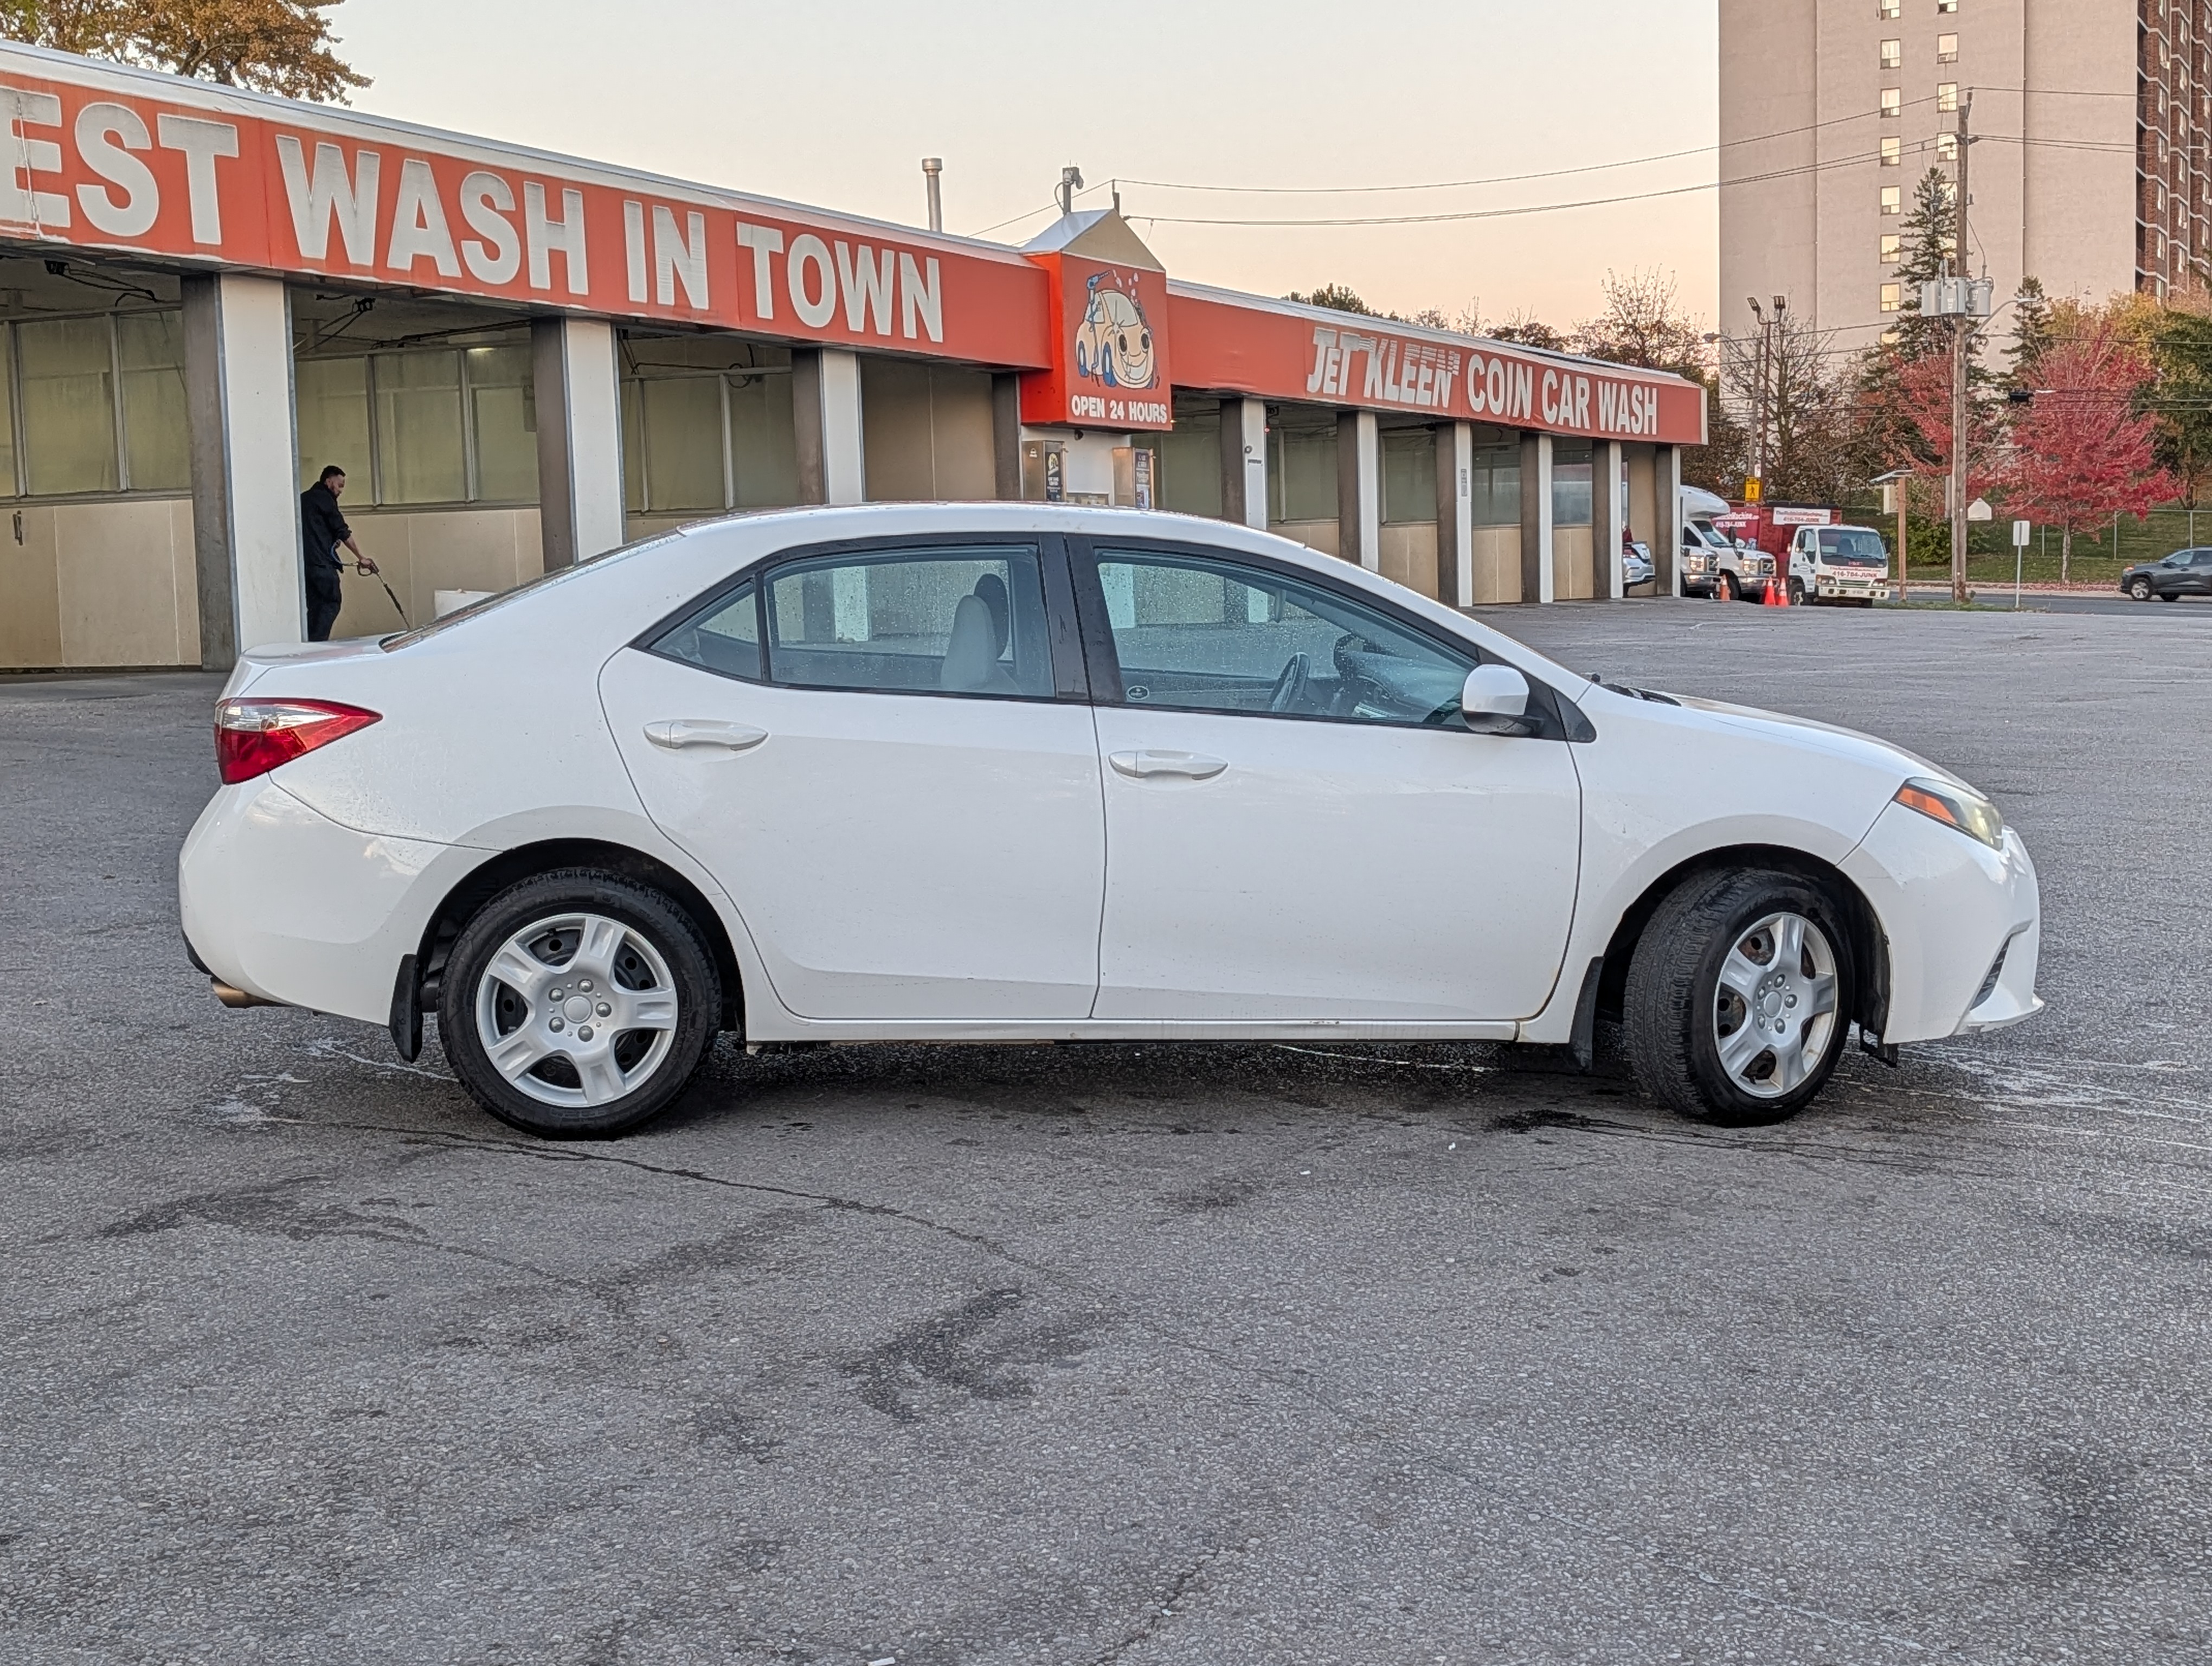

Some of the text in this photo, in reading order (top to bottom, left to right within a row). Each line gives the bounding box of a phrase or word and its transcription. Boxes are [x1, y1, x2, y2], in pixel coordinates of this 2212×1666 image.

[275, 134, 589, 296] WASH
[623, 200, 710, 310] IN
[736, 221, 943, 343] TOWN
[1071, 395, 1167, 424] OPEN 24 HOURS
[1360, 336, 1461, 408] KLEEN
[1467, 354, 1533, 419] COIN
[1542, 369, 1591, 429] CAR
[1598, 381, 1657, 435] WASH
